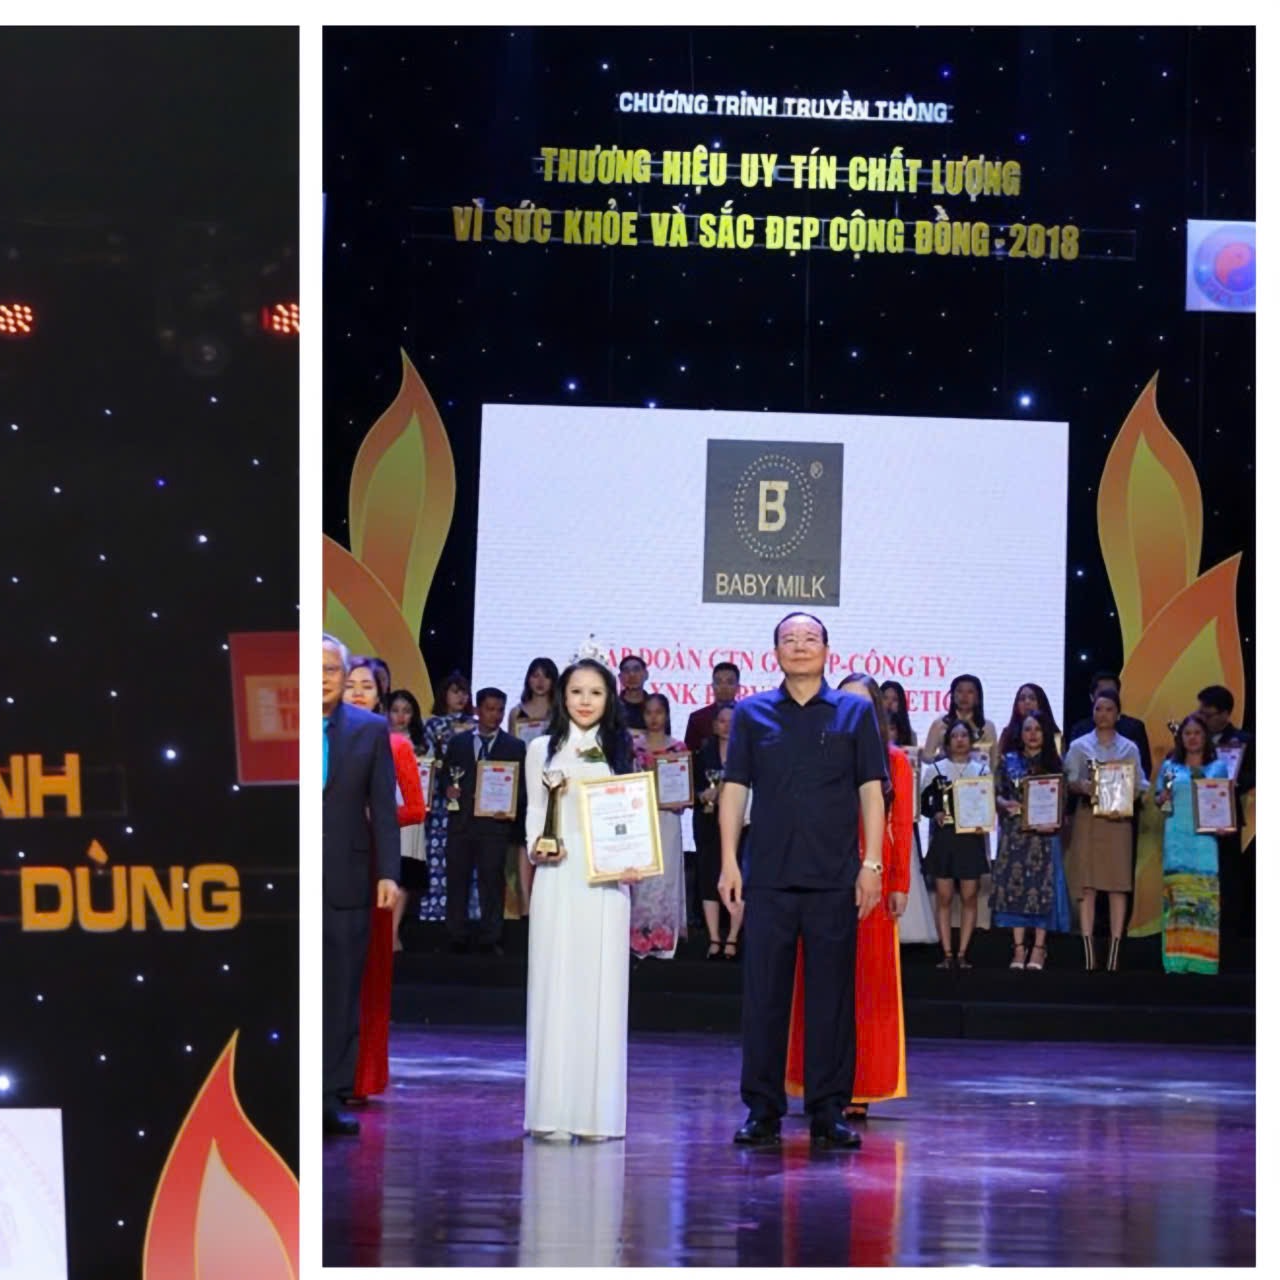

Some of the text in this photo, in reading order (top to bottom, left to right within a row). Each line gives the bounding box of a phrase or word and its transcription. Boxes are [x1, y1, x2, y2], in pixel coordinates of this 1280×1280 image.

[619, 89, 948, 122] CHƯƠNG TRÌNH TRUYỀN THÔNG
[541, 145, 1020, 201] THƯƠNG HIỆU UY TÍN CHẤT LƯỢNG
[452, 198, 483, 241] VÌ
[494, 200, 552, 243] SỨC
[564, 198, 638, 245] KHỎE
[651, 203, 688, 247] VÀ
[699, 200, 754, 248] SẮC
[765, 216, 819, 256] ĐẸP
[830, 209, 904, 259] CỘNG
[1008, 223, 1080, 260] 2018
[716, 573, 825, 598] BABY MILK
[920, 656, 949, 677] TY
[21, 839, 241, 932] DÙNG
